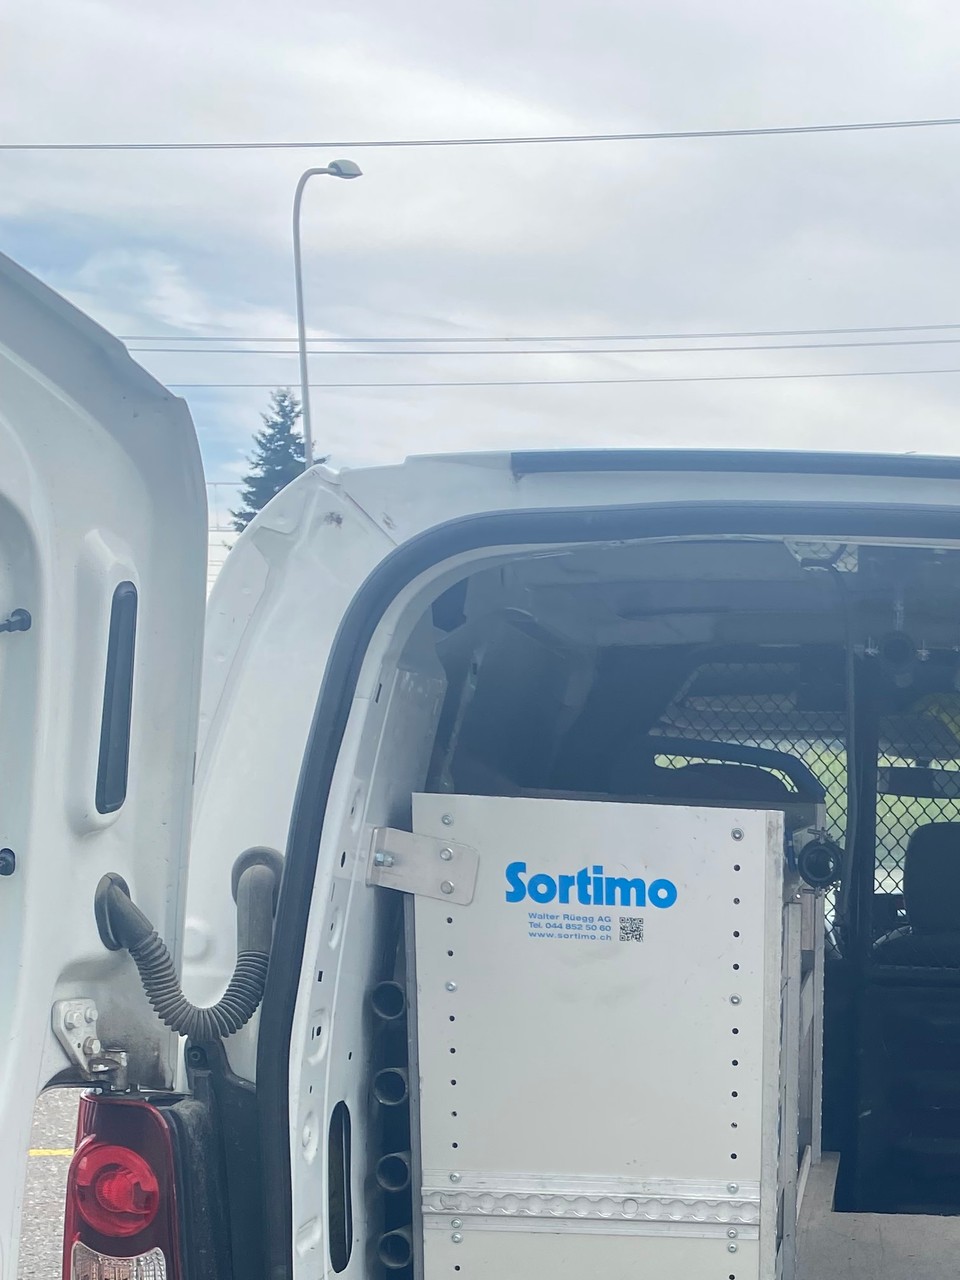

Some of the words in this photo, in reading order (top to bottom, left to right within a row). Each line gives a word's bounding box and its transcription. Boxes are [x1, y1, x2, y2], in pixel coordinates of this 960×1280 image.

[505, 861, 678, 909] Sortimo
[528, 912, 560, 920] Walter
[562, 913, 595, 924] Rüegg
[597, 915, 612, 923] AG
[545, 922, 563, 930] 044
[565, 923, 583, 931] 852
[599, 924, 612, 932] 60
[528, 932, 612, 941] www.sortimo.ch
